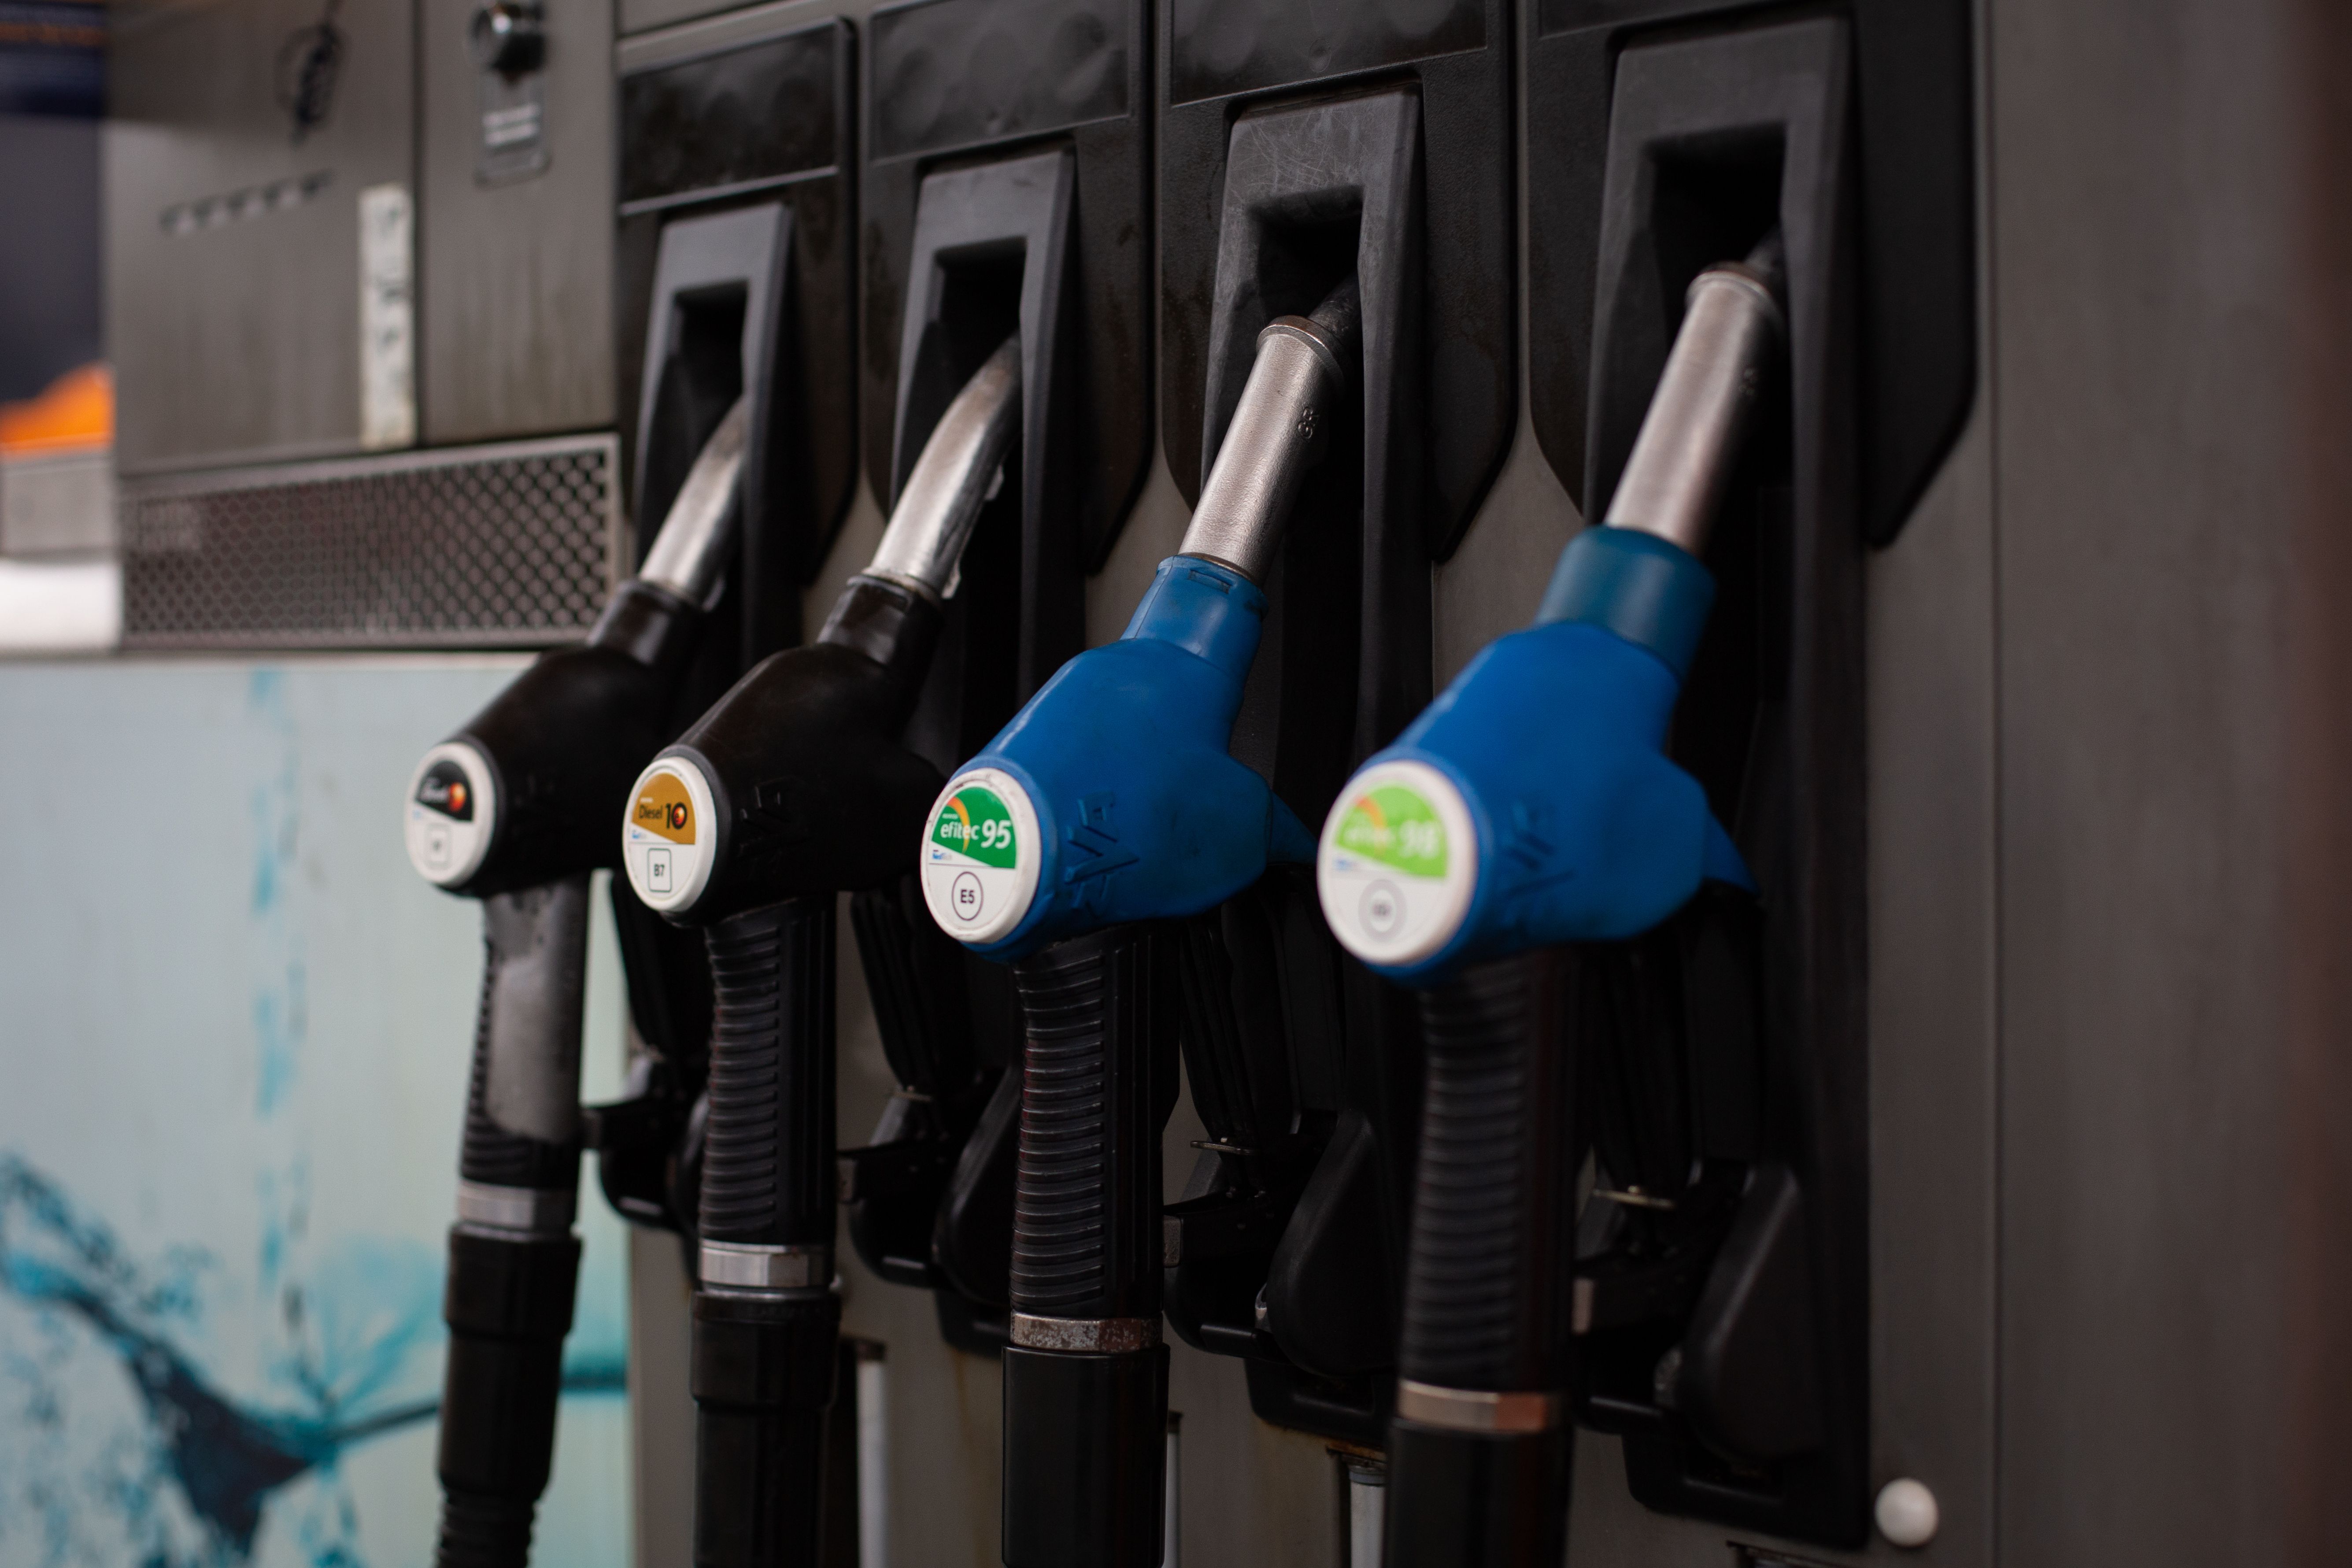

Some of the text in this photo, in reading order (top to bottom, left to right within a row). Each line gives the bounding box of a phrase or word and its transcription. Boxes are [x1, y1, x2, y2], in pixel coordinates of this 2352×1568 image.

[639, 802, 688, 830] Diesel 10
[940, 819, 1011, 849] efitec 95
[654, 864, 665, 876] B7
[960, 889, 975, 904] E5
